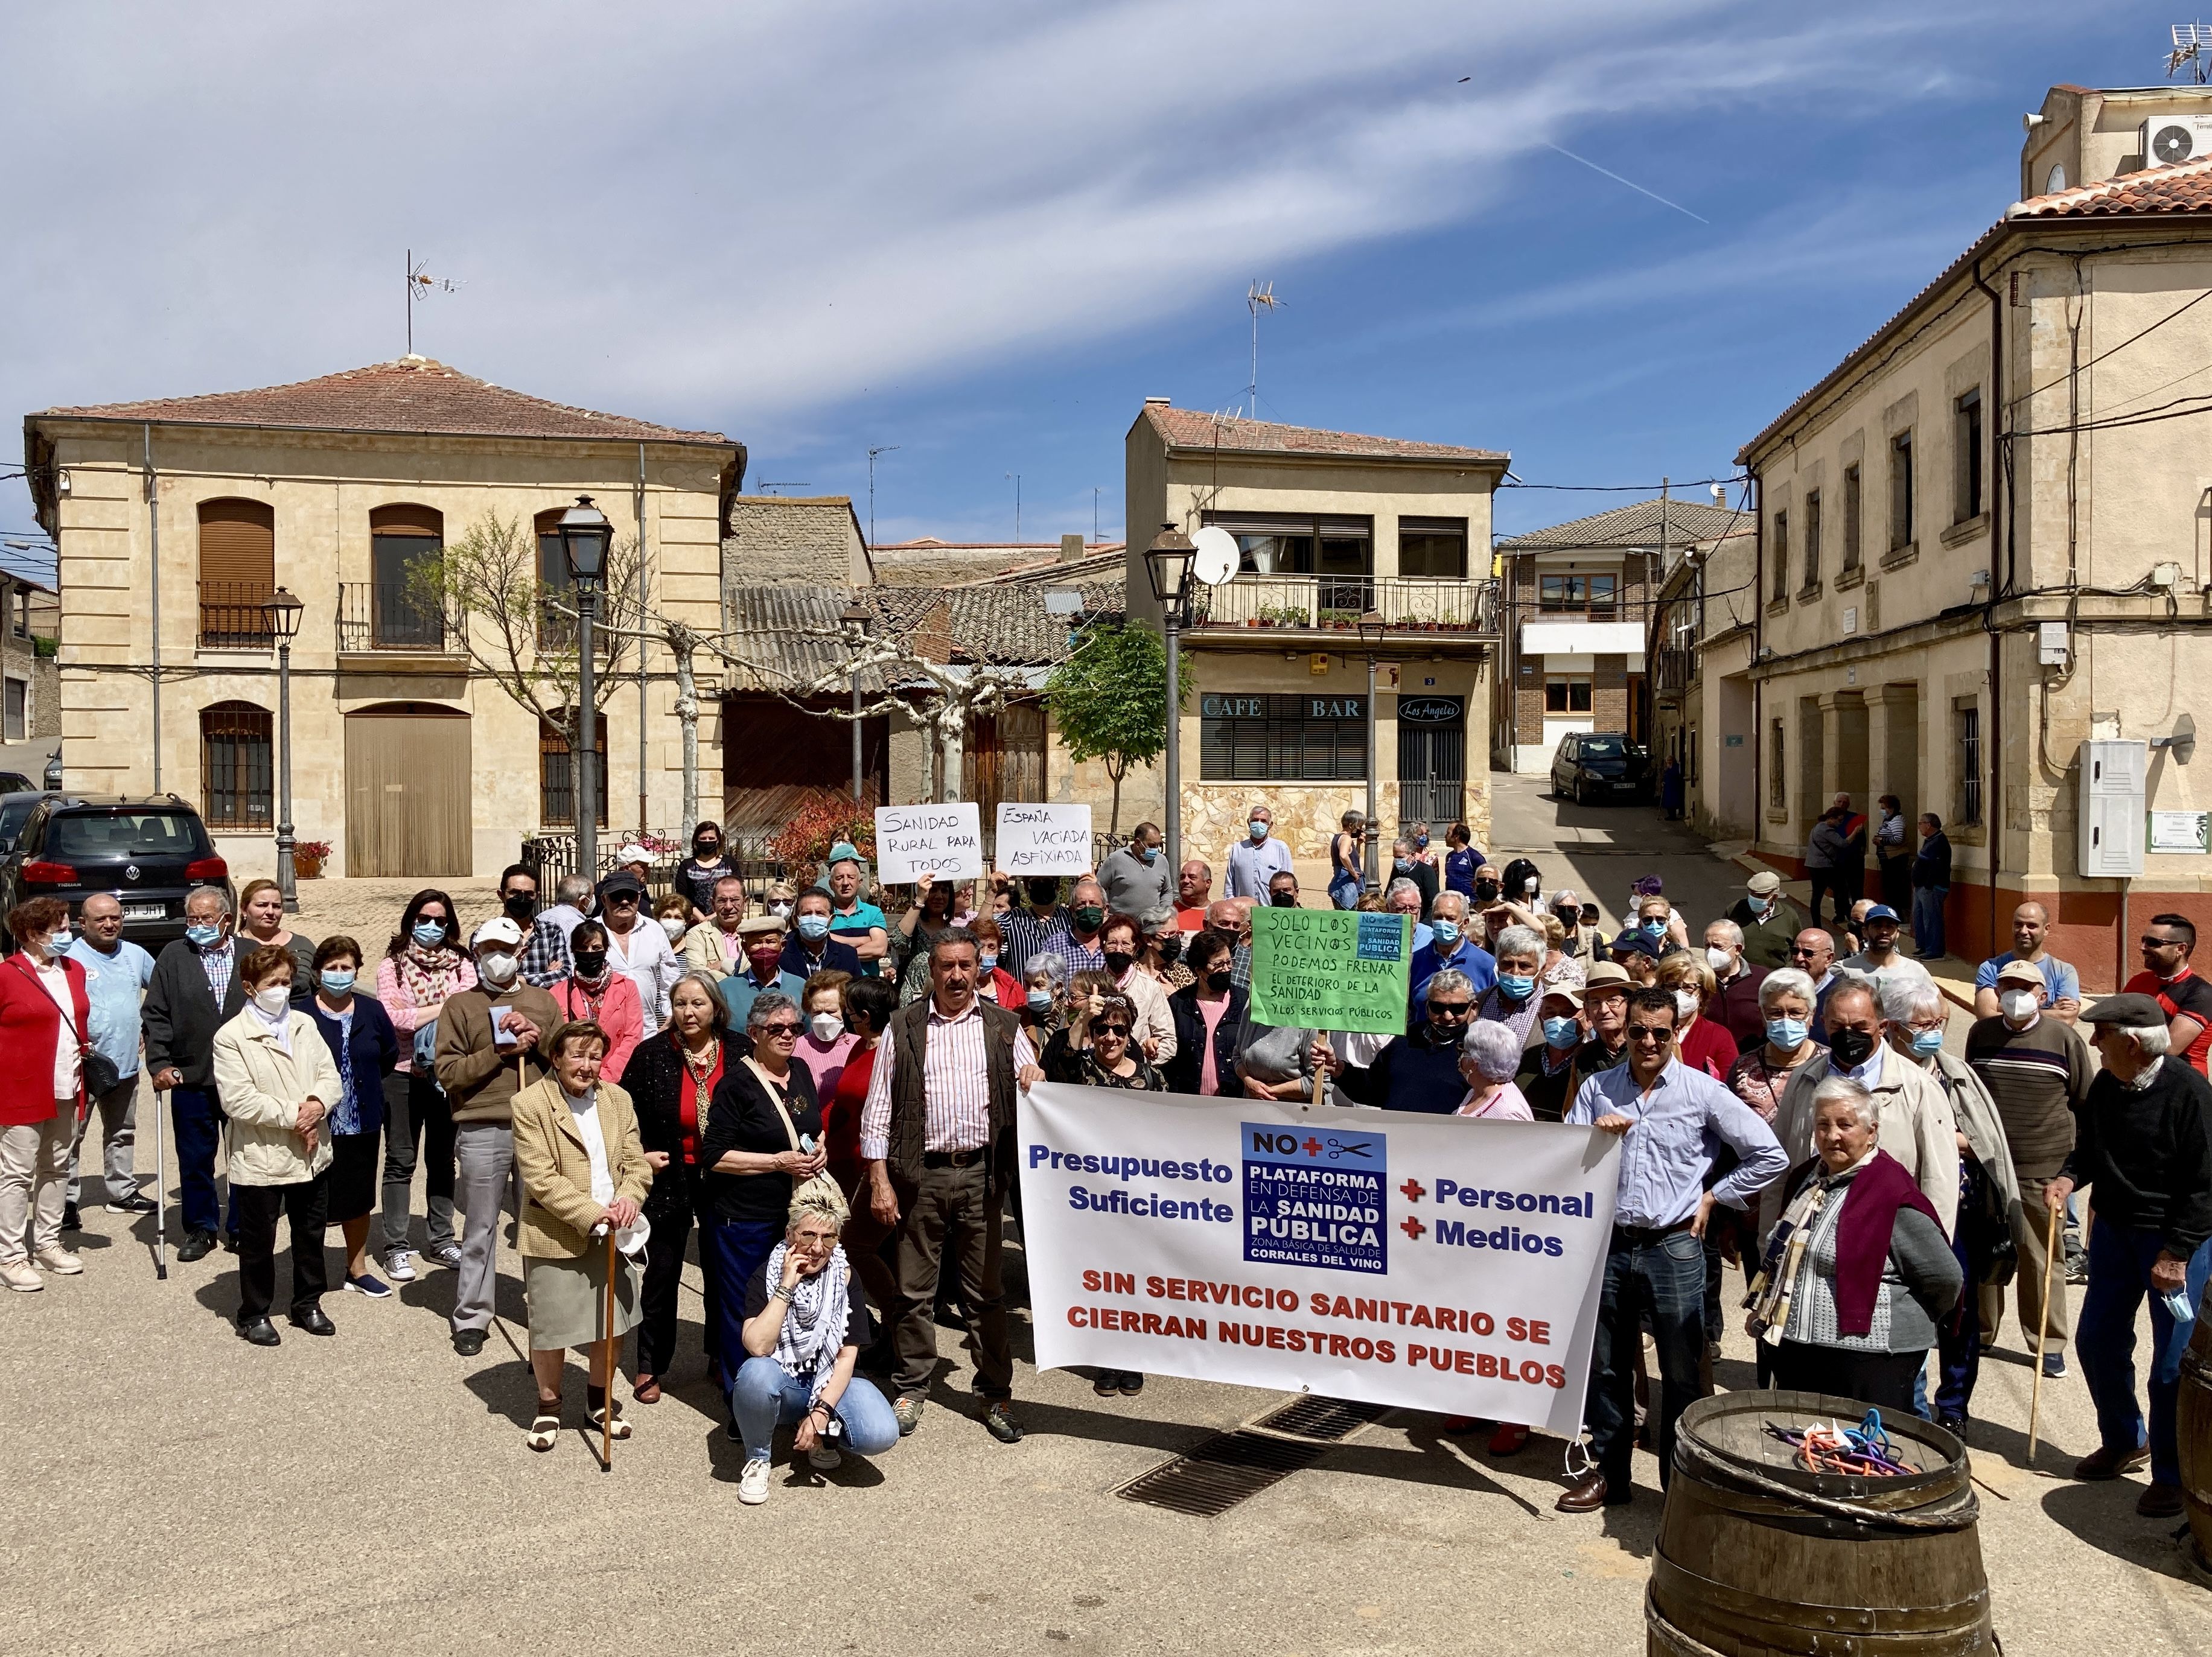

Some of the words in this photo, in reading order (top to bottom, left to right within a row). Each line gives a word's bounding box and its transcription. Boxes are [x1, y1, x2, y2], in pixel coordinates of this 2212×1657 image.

[1203, 697, 1261, 716] CAFÉ
[1312, 699, 1359, 717] BAR
[1404, 703, 1420, 716] Los
[1421, 702, 1455, 719] Angeles
[882, 813, 959, 833] SANIDAD
[1003, 807, 1053, 824] ESPAÑA
[888, 838, 938, 853] RURAL
[947, 836, 976, 848] PARA
[908, 857, 961, 873] TODOS
[124, 906, 136, 915] 81
[142, 905, 163, 915] JHT
[1362, 915, 1376, 924] NO
[1268, 912, 1310, 931] SOLO
[1359, 943, 1399, 953] PÚBLICA
[1273, 954, 1337, 972] PODEMOS
[1347, 960, 1397, 980] FRENAR
[1270, 985, 1321, 1000] SANIDAD
[1272, 974, 1281, 984] EL
[1287, 975, 1339, 990] DETERIORO
[1348, 981, 1360, 990] DE
[1365, 982, 1379, 993] LA
[1301, 1007, 1345, 1016] SERVICIOS
[1349, 1007, 1392, 1019] PÚBLICOS
[1029, 1145, 1232, 1183] Presupuesto
[1250, 1166, 1379, 1190] PLATAFORMA
[1251, 1181, 1271, 1195] EN
[1278, 1183, 1353, 1203] DEFENSA
[1358, 1191, 1379, 1205] DE
[1435, 1178, 1593, 1218] Personal
[1069, 1186, 1234, 1223] Suficiente
[1251, 1200, 1269, 1213] LA
[1277, 1200, 1379, 1224] SANIDAD
[1251, 1213, 1380, 1247] PÚBLICA
[1435, 1219, 1563, 1256] Medios
[1251, 1237, 1280, 1248] ZONA
[1283, 1239, 1315, 1251] BÁSICA
[1318, 1244, 1330, 1253] DE
[1333, 1245, 1365, 1257] SALUD
[1368, 1248, 1381, 1258] DE
[1251, 1248, 1318, 1263] CORRALES
[1322, 1255, 1347, 1265] DEL
[1350, 1258, 1382, 1270] VINO
[1082, 1270, 1135, 1295] SIN
[1146, 1276, 1299, 1312] SERVICIO
[1310, 1293, 1495, 1336] SANITARIO
[1506, 1317, 1551, 1344] SE
[1067, 1306, 1207, 1340] CIERRAN
[1219, 1321, 1395, 1363] NUESTROS
[1407, 1343, 1566, 1389] PUEBLOS
